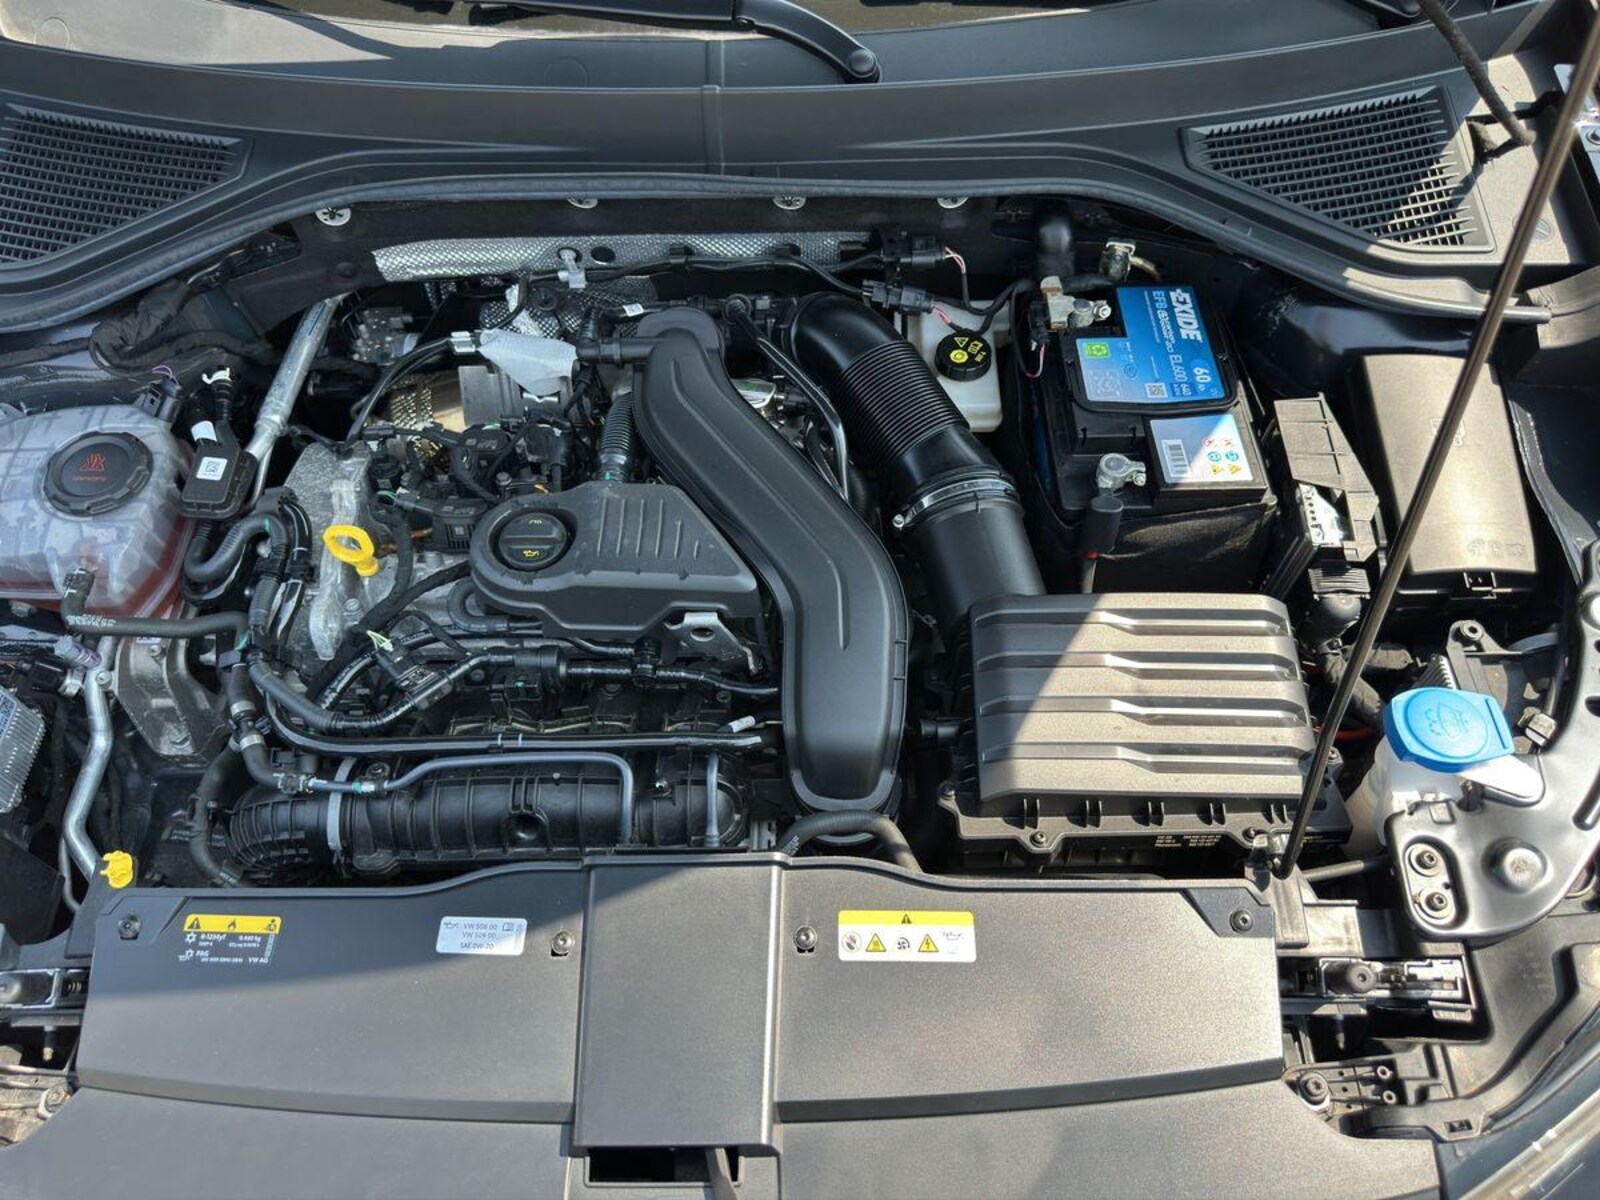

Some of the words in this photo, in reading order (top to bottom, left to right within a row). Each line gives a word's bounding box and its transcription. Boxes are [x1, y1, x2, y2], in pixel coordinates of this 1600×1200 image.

[1152, 290, 1167, 309] EFB
[1169, 289, 1203, 343] EXIDE
[1169, 354, 1188, 381] EL600
[1193, 367, 1211, 383] 60
